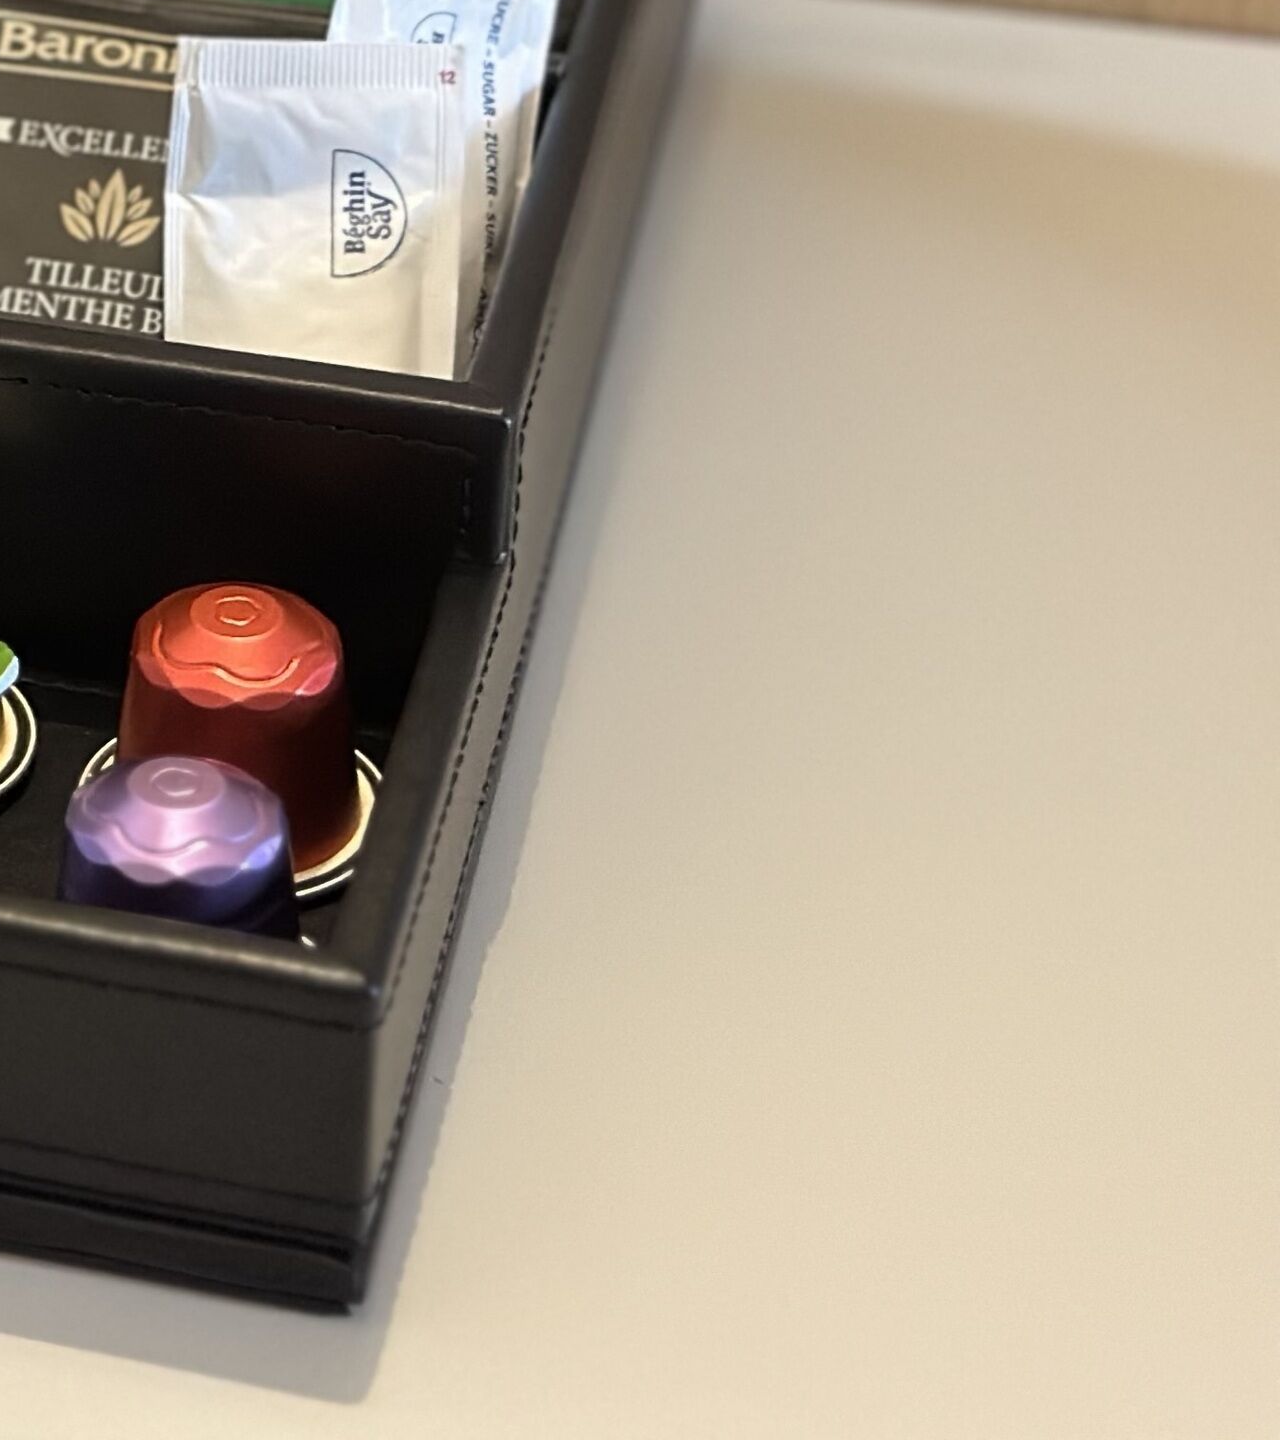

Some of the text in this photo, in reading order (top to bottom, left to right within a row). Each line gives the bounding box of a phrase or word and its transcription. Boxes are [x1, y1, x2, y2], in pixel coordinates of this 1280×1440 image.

[482, 60, 497, 116] SUGAR
[484, 132, 498, 197] ZUCKER
[342, 171, 371, 255] Béghin
[365, 188, 398, 239] Say
